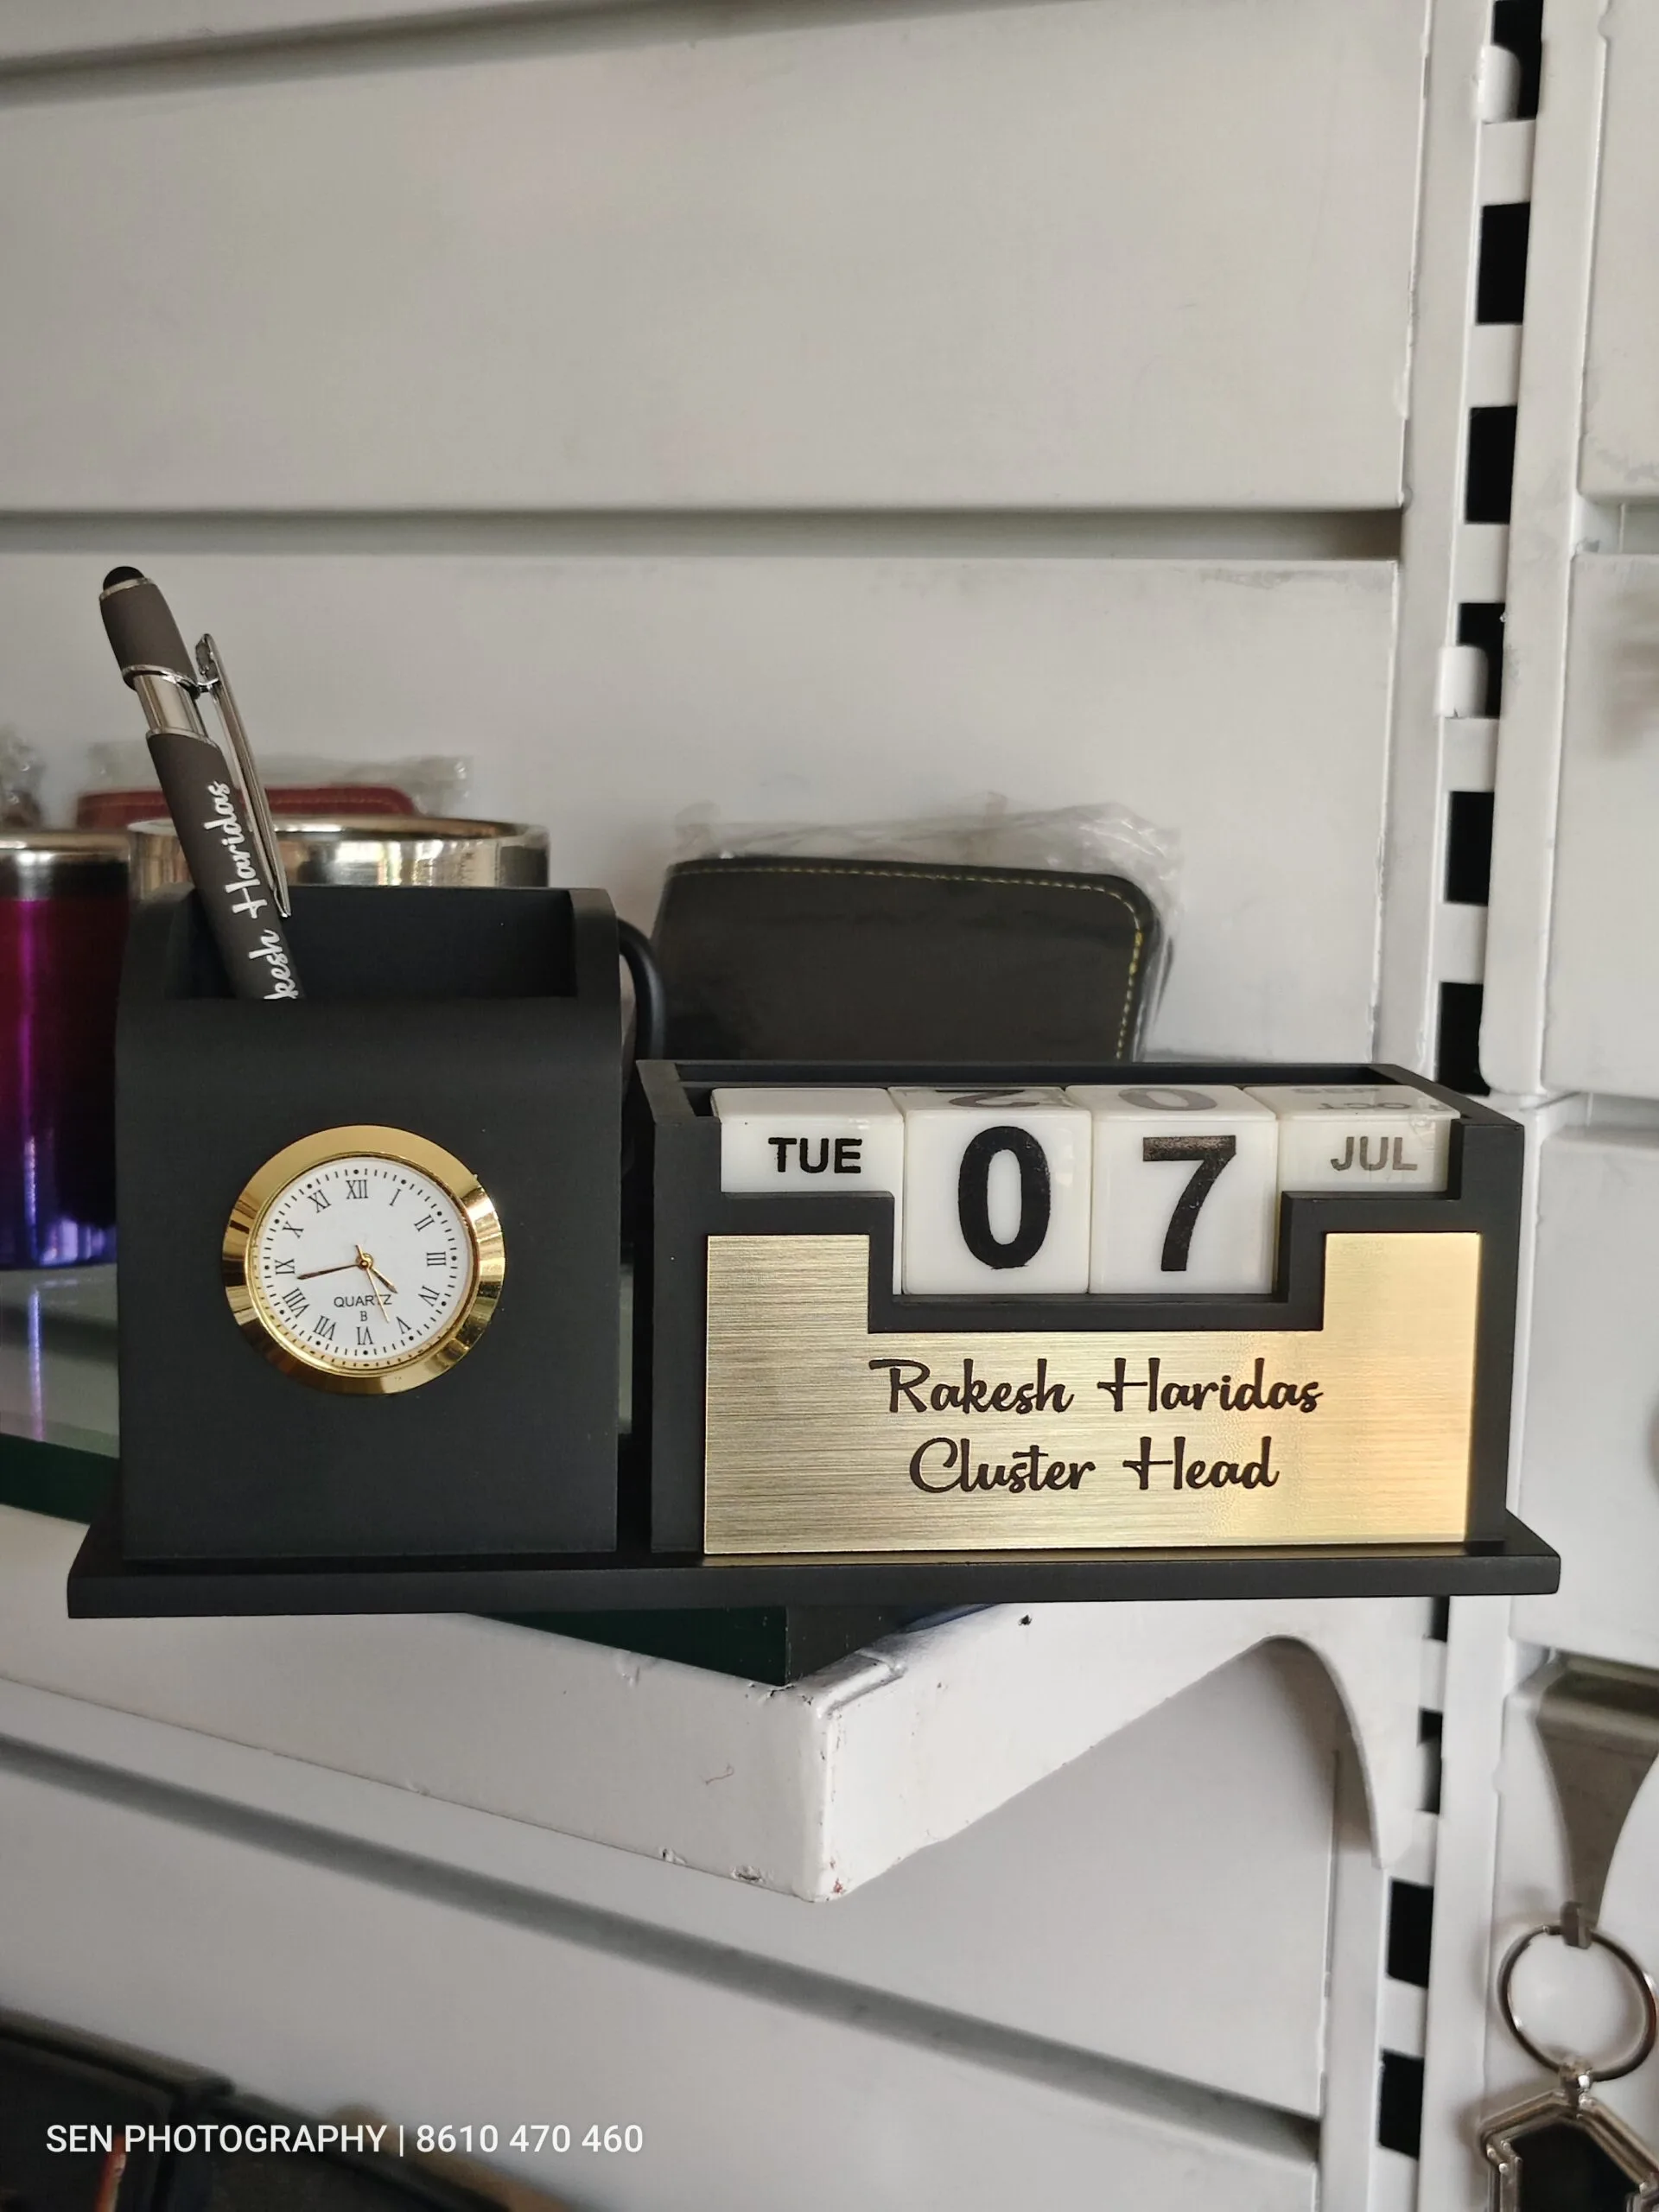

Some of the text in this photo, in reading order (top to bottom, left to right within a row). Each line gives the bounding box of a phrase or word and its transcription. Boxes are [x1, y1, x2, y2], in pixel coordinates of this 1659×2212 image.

[204, 780, 268, 919] Haridas
[767, 1136, 863, 1174] TUE
[1330, 1135, 1418, 1172] JUL
[346, 1179, 369, 1199] XII
[389, 1188, 402, 1206] I
[307, 1189, 332, 1214] XI
[282, 1220, 304, 1238] X
[413, 1214, 435, 1232] II
[274, 1258, 295, 1275] IX
[426, 1250, 447, 1267] III
[282, 1287, 310, 1319] VIII
[417, 1285, 441, 1307] IV
[312, 1315, 336, 1342] VII
[356, 1326, 374, 1345] VI
[396, 1316, 412, 1335] V
[868, 1357, 1325, 1415] Rakesh Haridas
[909, 1435, 1281, 1494] Cluster Head
